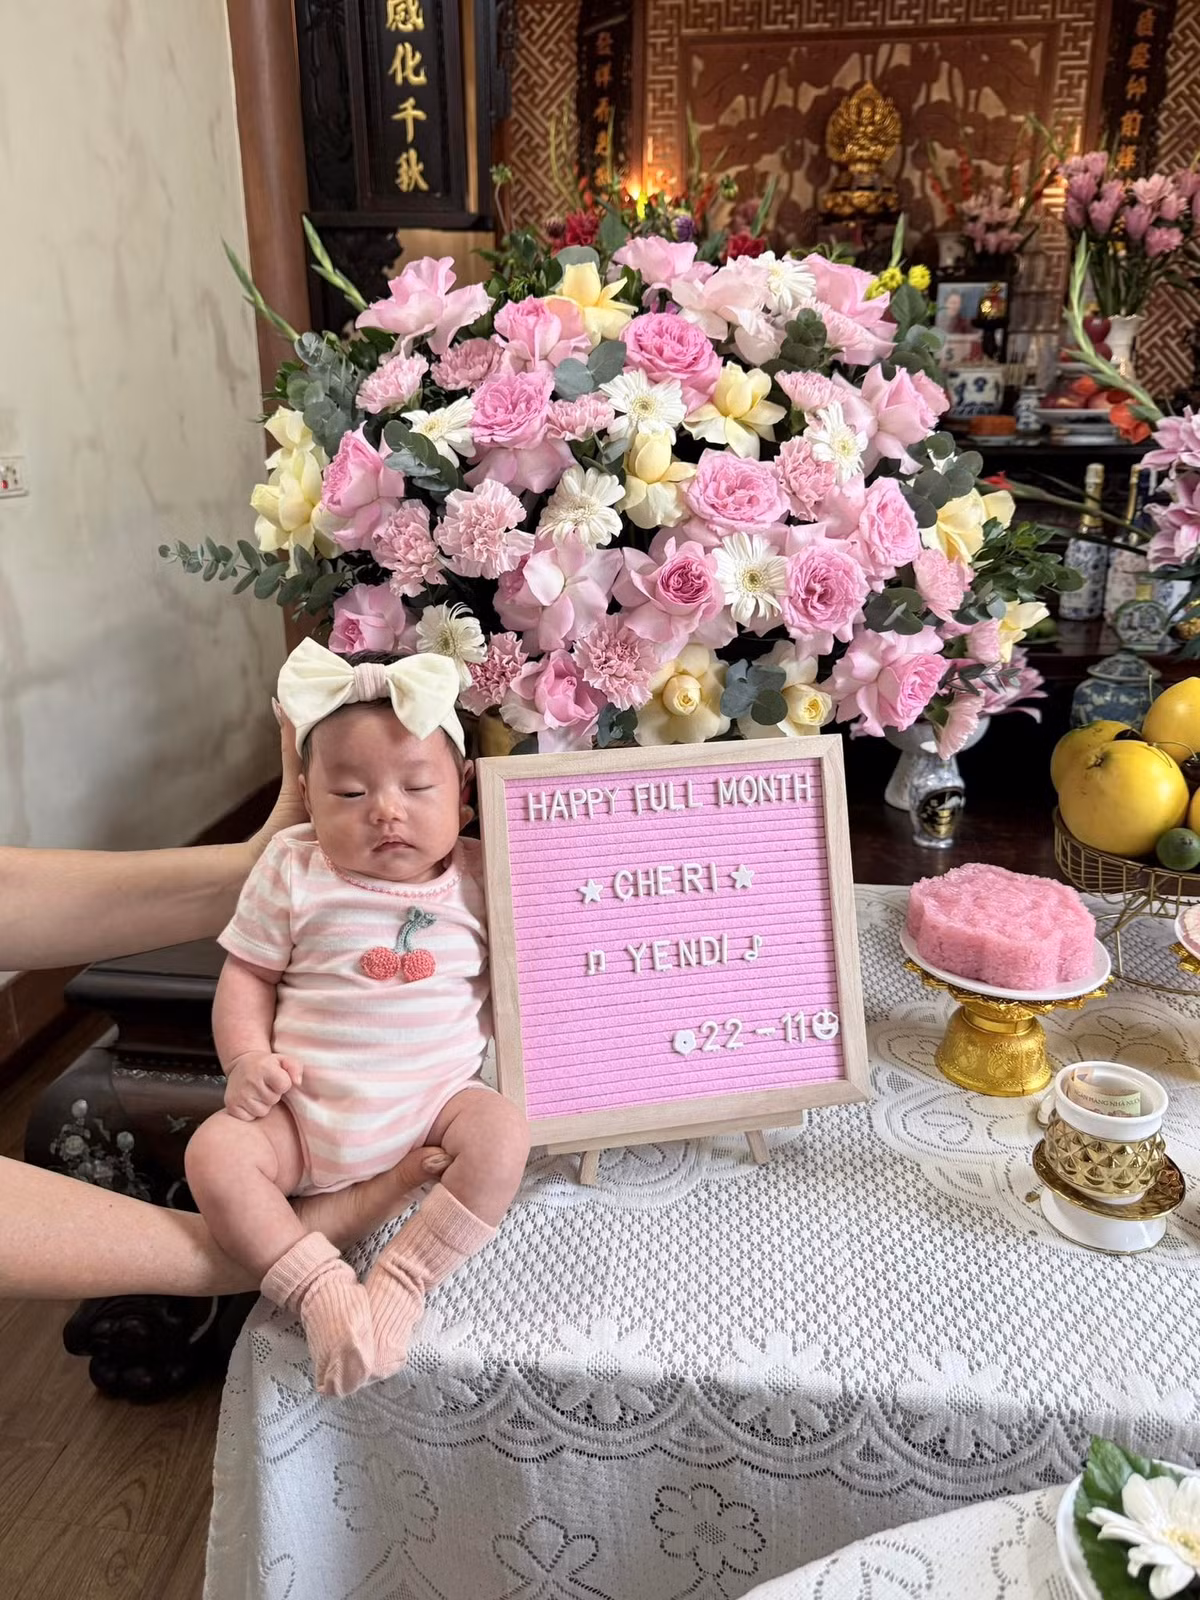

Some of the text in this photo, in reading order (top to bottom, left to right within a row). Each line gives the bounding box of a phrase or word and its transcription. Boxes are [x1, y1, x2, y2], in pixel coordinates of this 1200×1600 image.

[527, 773, 812, 823] HAPPY FULL MONTH
[613, 861, 718, 902] CHERI
[626, 934, 729, 974] YENDI
